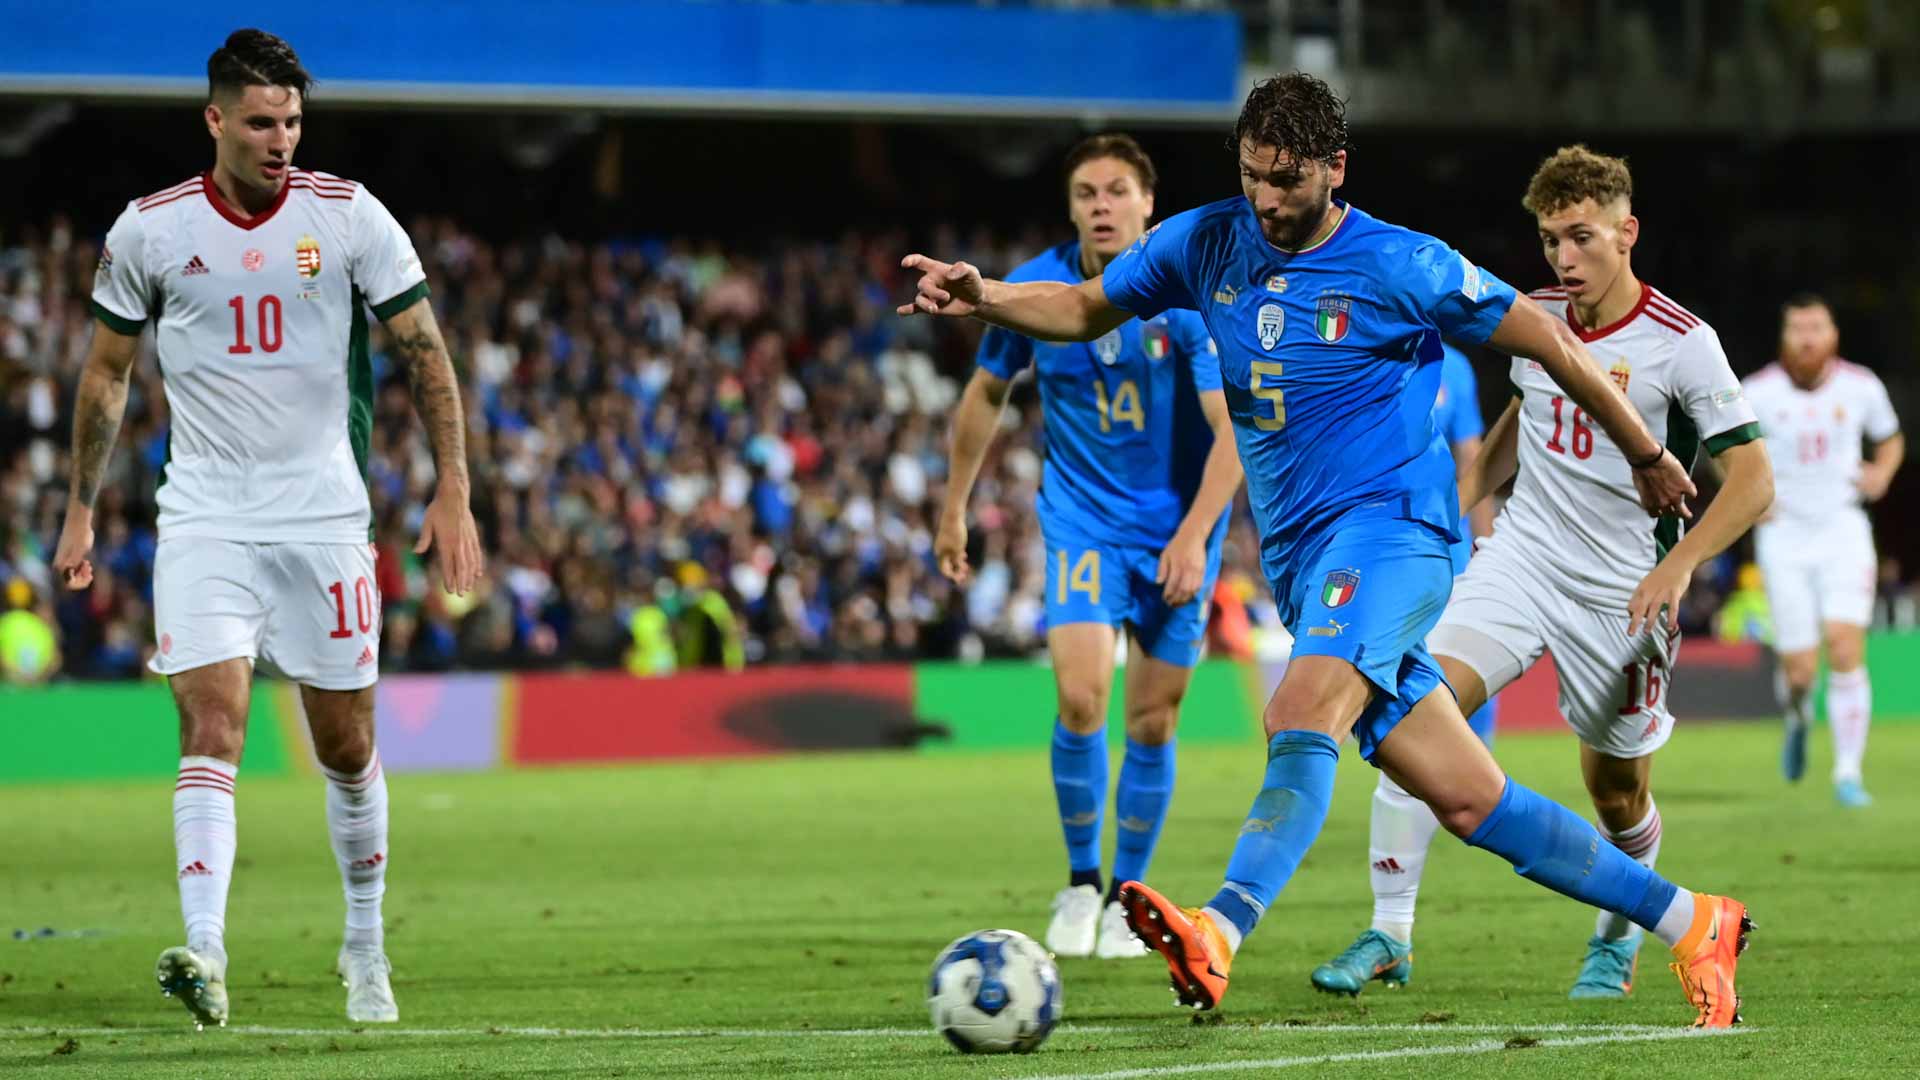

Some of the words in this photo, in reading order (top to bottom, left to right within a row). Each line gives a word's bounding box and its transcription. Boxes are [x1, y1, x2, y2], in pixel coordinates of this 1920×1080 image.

[228, 295, 283, 354] 10
[1093, 380, 1145, 432] 14
[1250, 361, 1286, 432] 5
[1546, 396, 1594, 460] 16
[329, 576, 372, 639] 10
[1057, 549, 1101, 605] 14
[1617, 655, 1662, 716] 16
